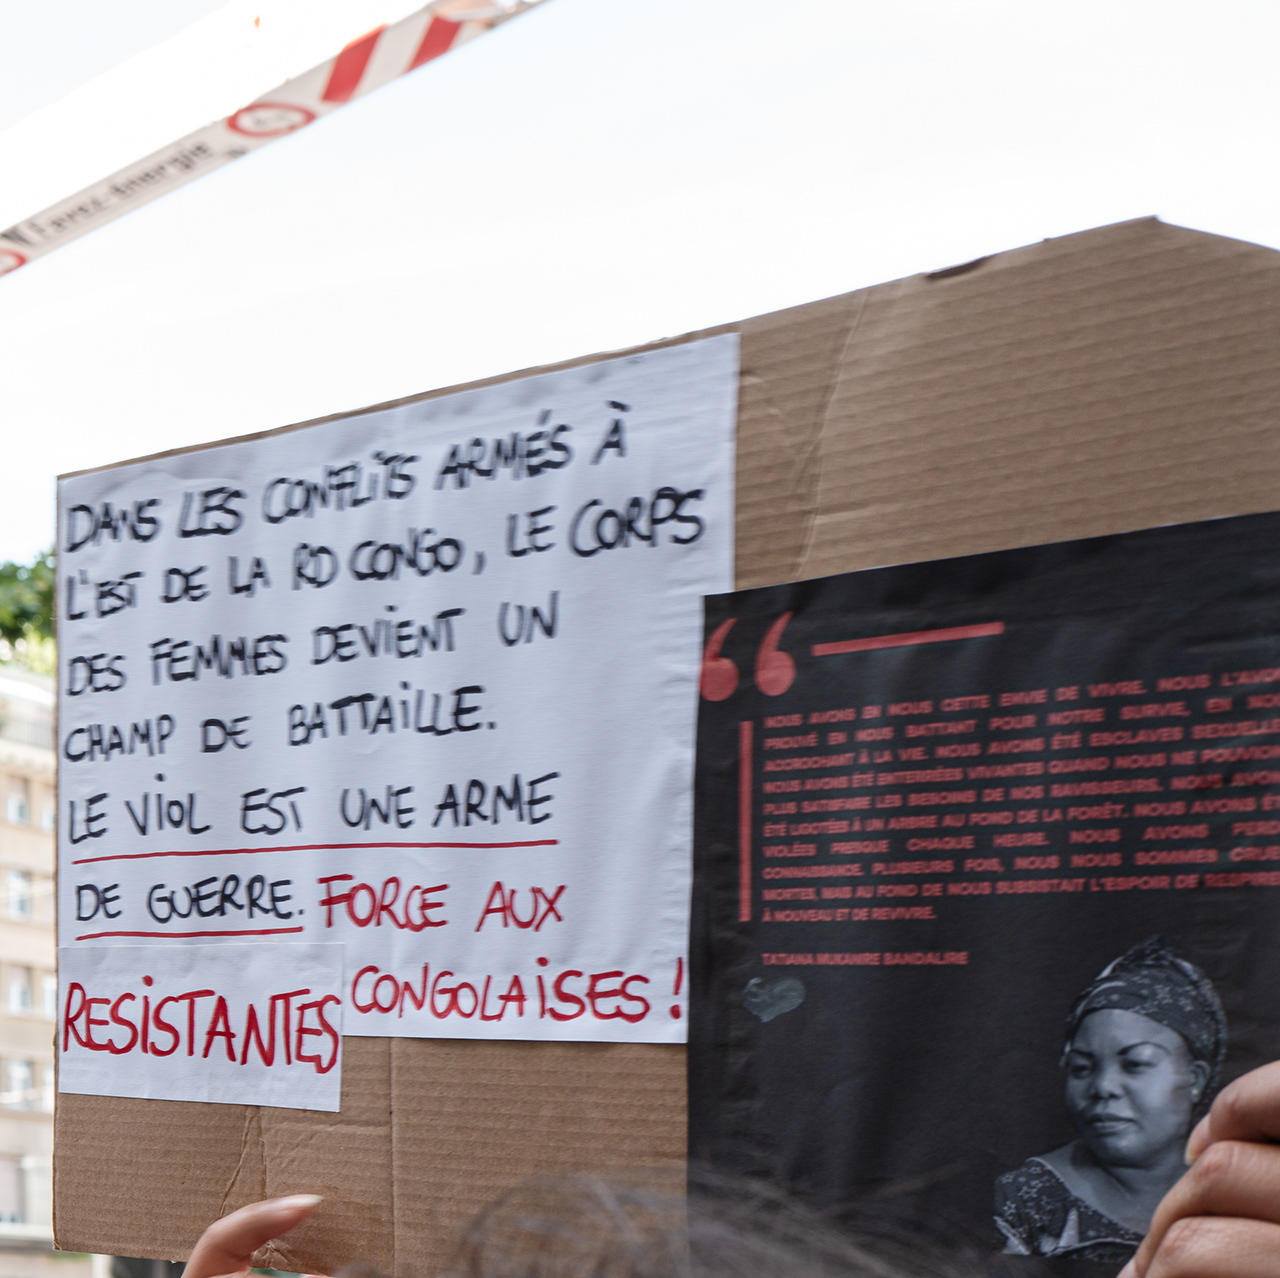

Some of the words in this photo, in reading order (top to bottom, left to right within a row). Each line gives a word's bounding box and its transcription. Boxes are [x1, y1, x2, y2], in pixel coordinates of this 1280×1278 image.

[67, 498, 158, 553] DANS
[180, 486, 244, 539] LES
[439, 410, 573, 490] ARMÉS
[591, 400, 629, 465] À
[68, 571, 142, 621] L'EST
[162, 566, 207, 604] DE
[229, 556, 270, 596] LA
[351, 528, 484, 581] CONGO,
[509, 505, 554, 558] LE
[571, 486, 704, 558] CORPS
[68, 653, 124, 697] DES
[151, 634, 287, 682] FEMMES
[313, 605, 464, 665] DEVIENT
[501, 593, 557, 647] UN
[64, 714, 173, 763] CHAMP
[201, 716, 249, 753] DE
[70, 792, 108, 845] LE
[241, 786, 306, 836] EST
[341, 786, 414, 830] UNE
[433, 771, 559, 827] ARME
[76, 883, 122, 922] DE
[147, 873, 304, 924] GUERRE.
[318, 873, 449, 933] FORCE
[475, 881, 566, 932] AUX
